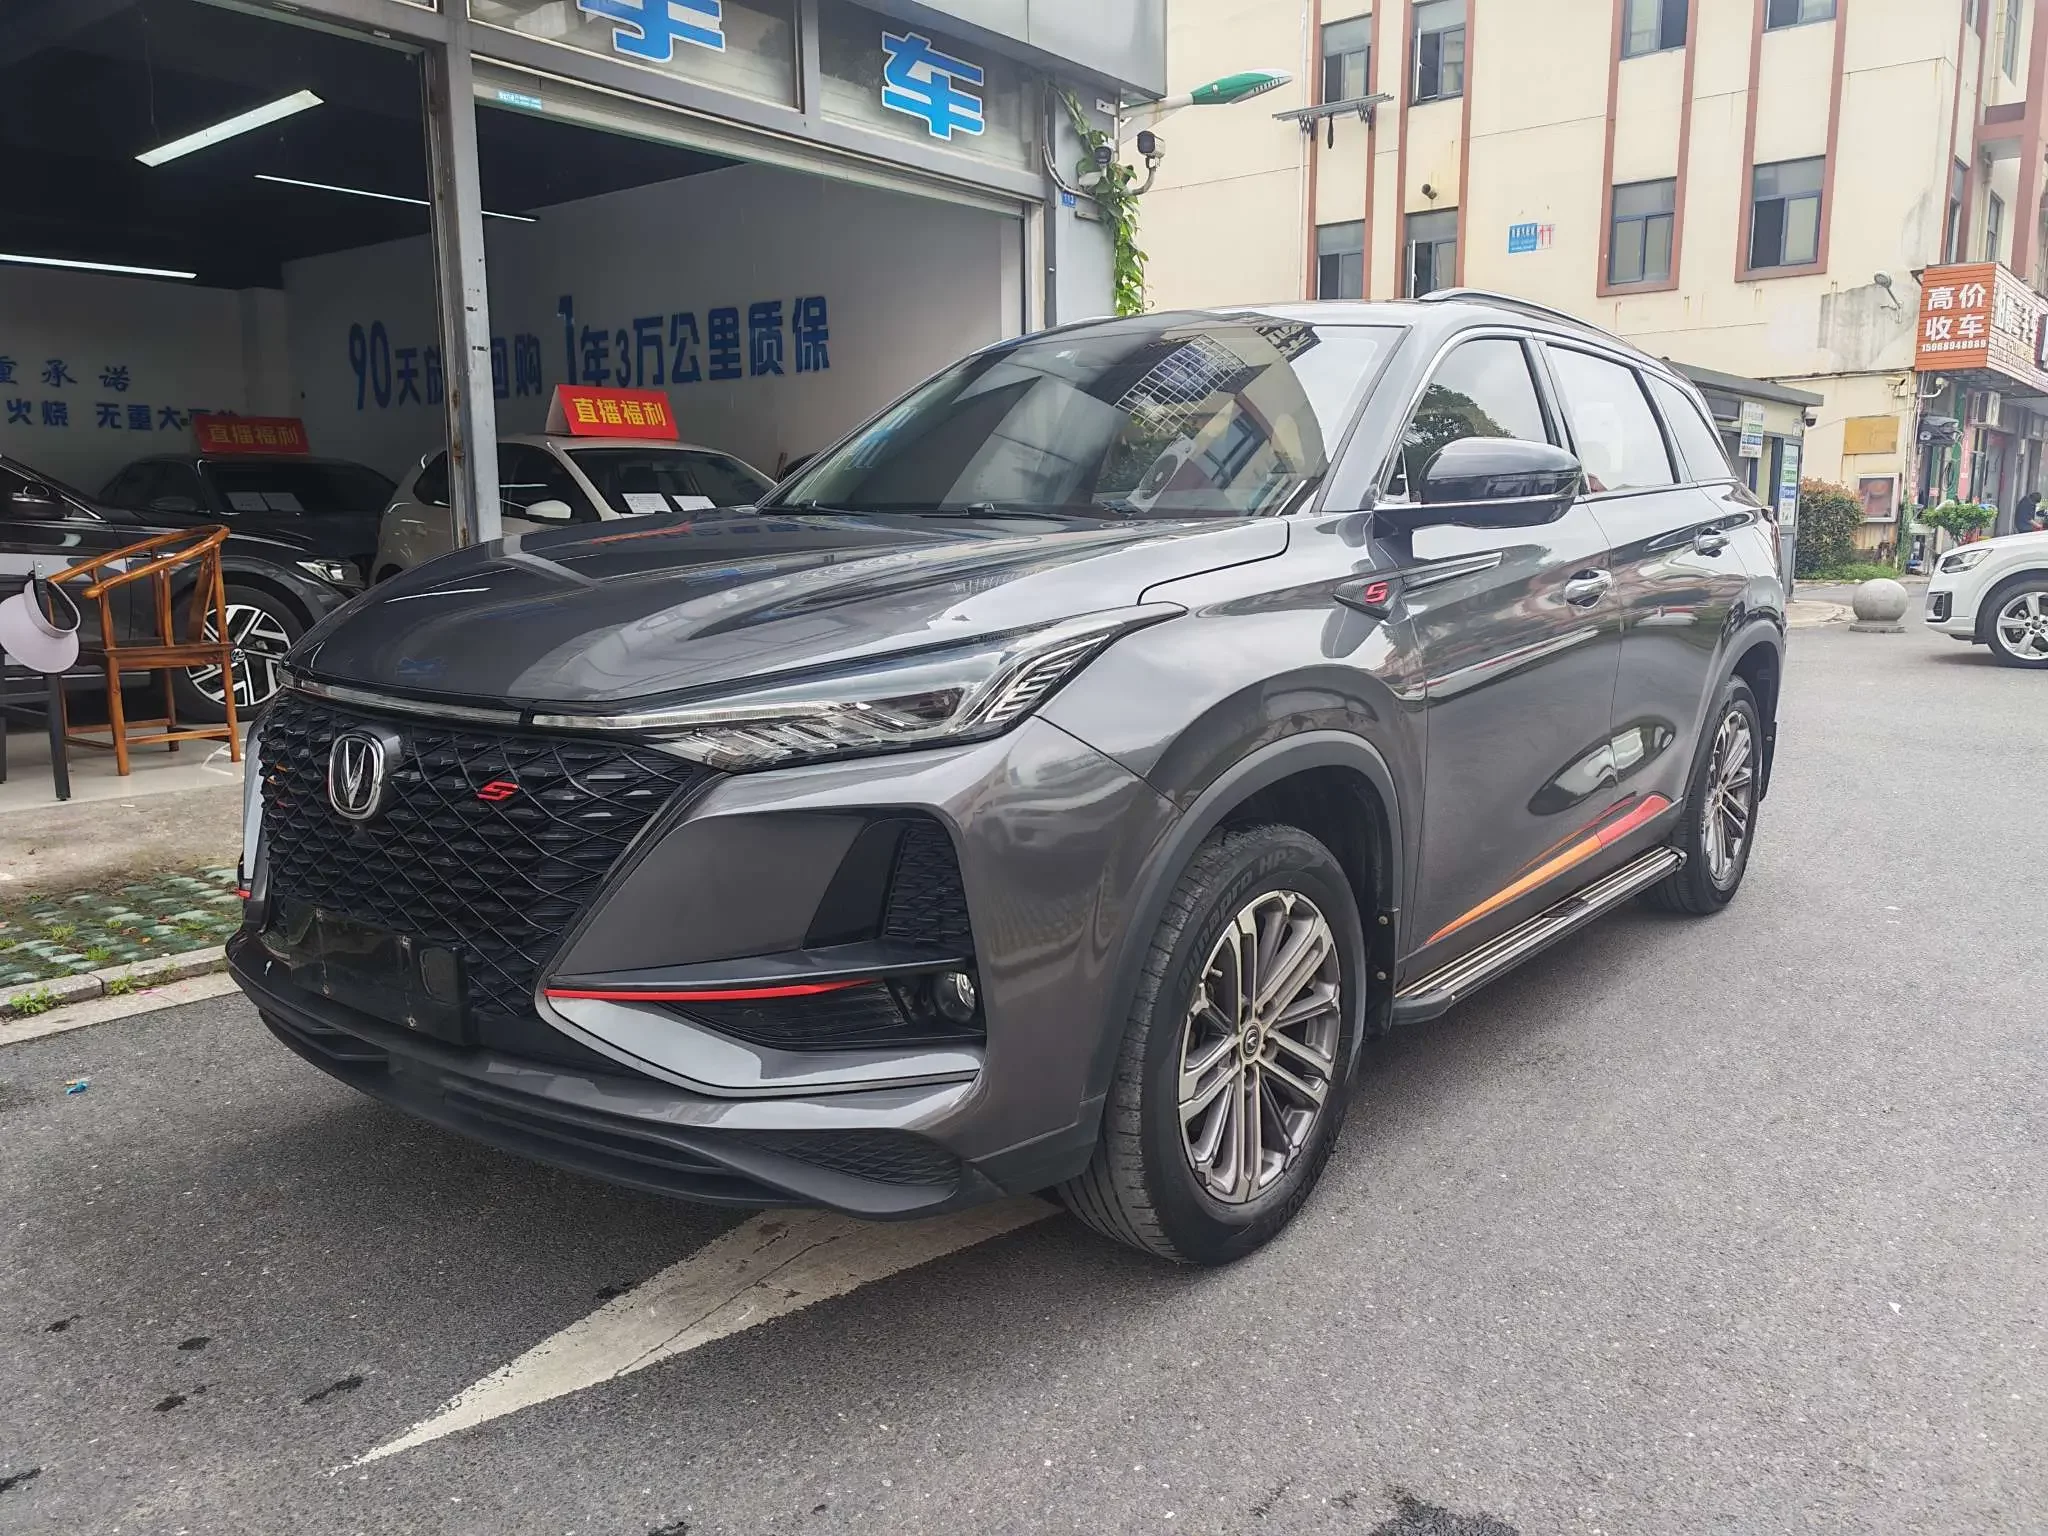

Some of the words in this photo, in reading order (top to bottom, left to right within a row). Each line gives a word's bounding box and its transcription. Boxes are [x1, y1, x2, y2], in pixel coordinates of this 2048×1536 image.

[882, 32, 984, 140] 车
[1928, 283, 1986, 311] 高价
[1926, 314, 1984, 341] 收车
[348, 320, 543, 411] 90天放回购
[572, 397, 668, 427] 直播福利
[208, 423, 298, 446] 直播福利
